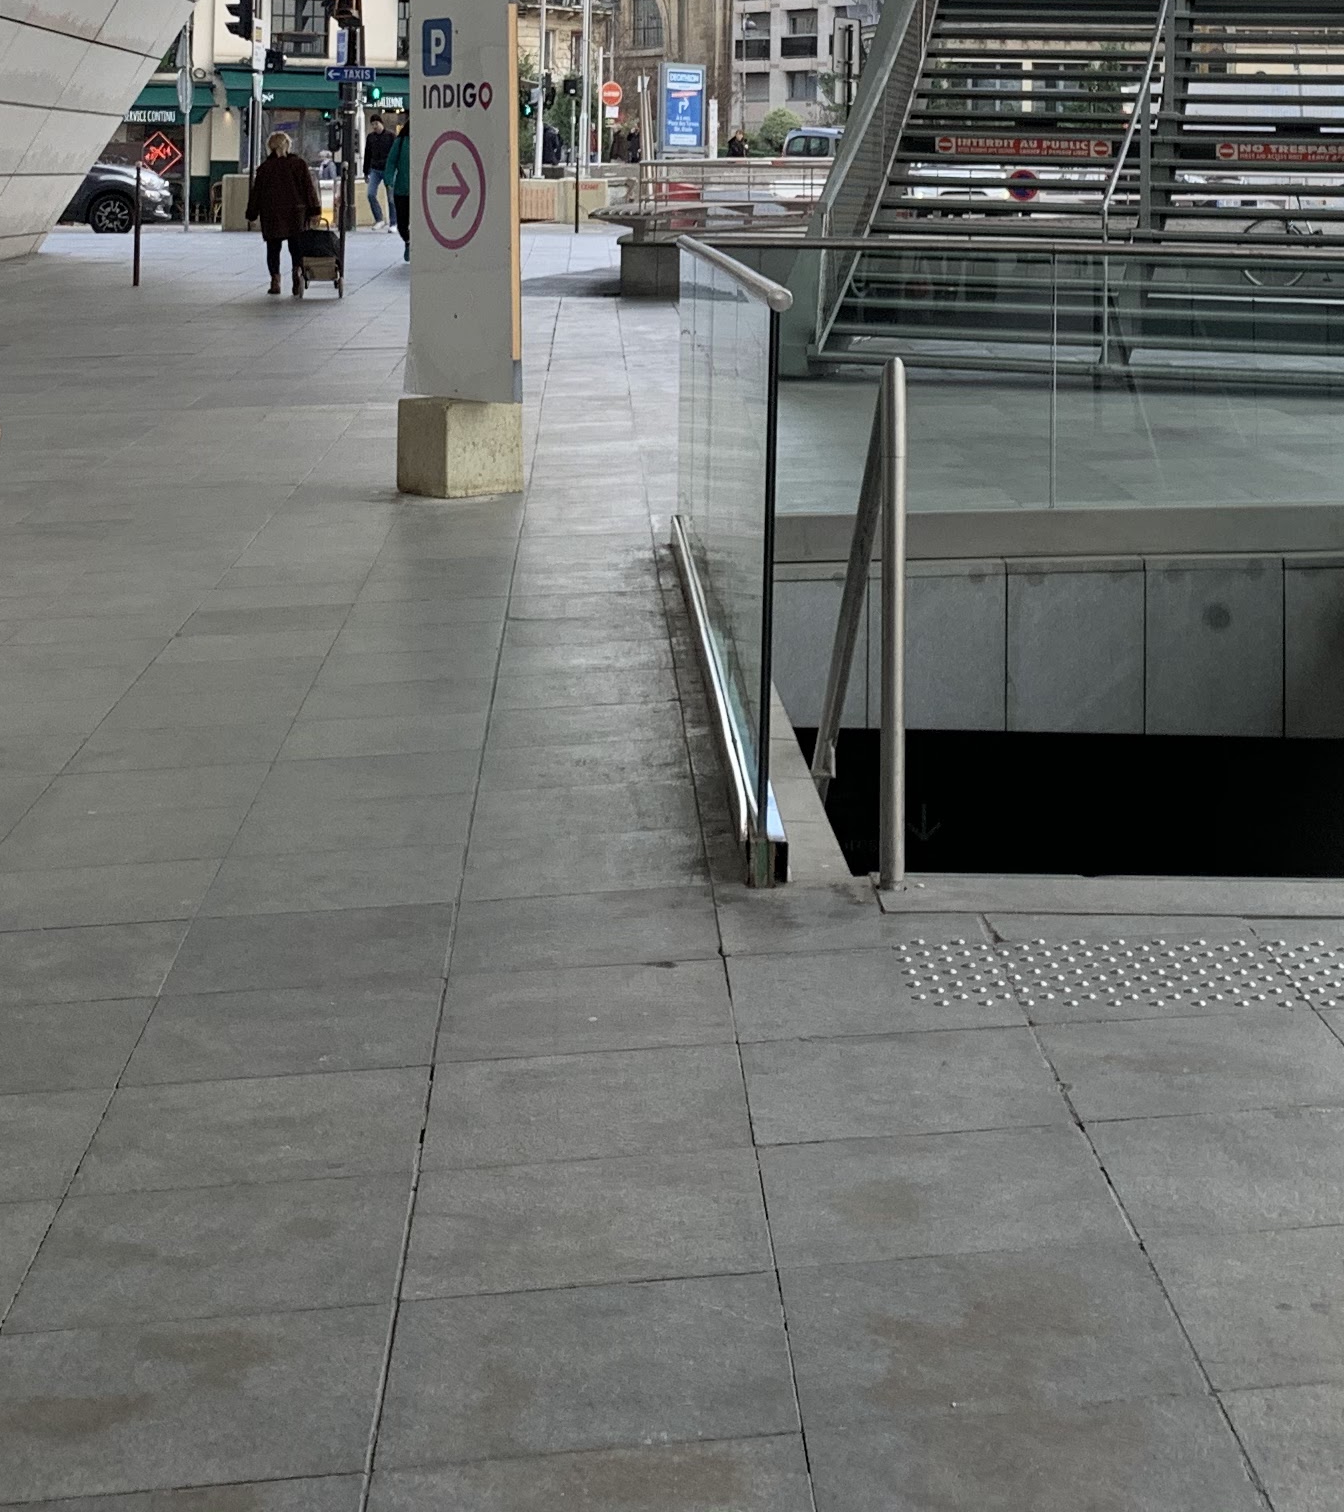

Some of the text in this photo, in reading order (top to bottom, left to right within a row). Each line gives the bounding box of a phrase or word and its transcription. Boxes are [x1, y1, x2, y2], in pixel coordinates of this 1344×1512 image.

[430, 28, 447, 67] P
[343, 69, 372, 80] TAXIS
[422, 82, 494, 111] INDIGO
[957, 138, 1089, 150] INTERDIT AU PUBLIC
[1239, 144, 1265, 153] NO
